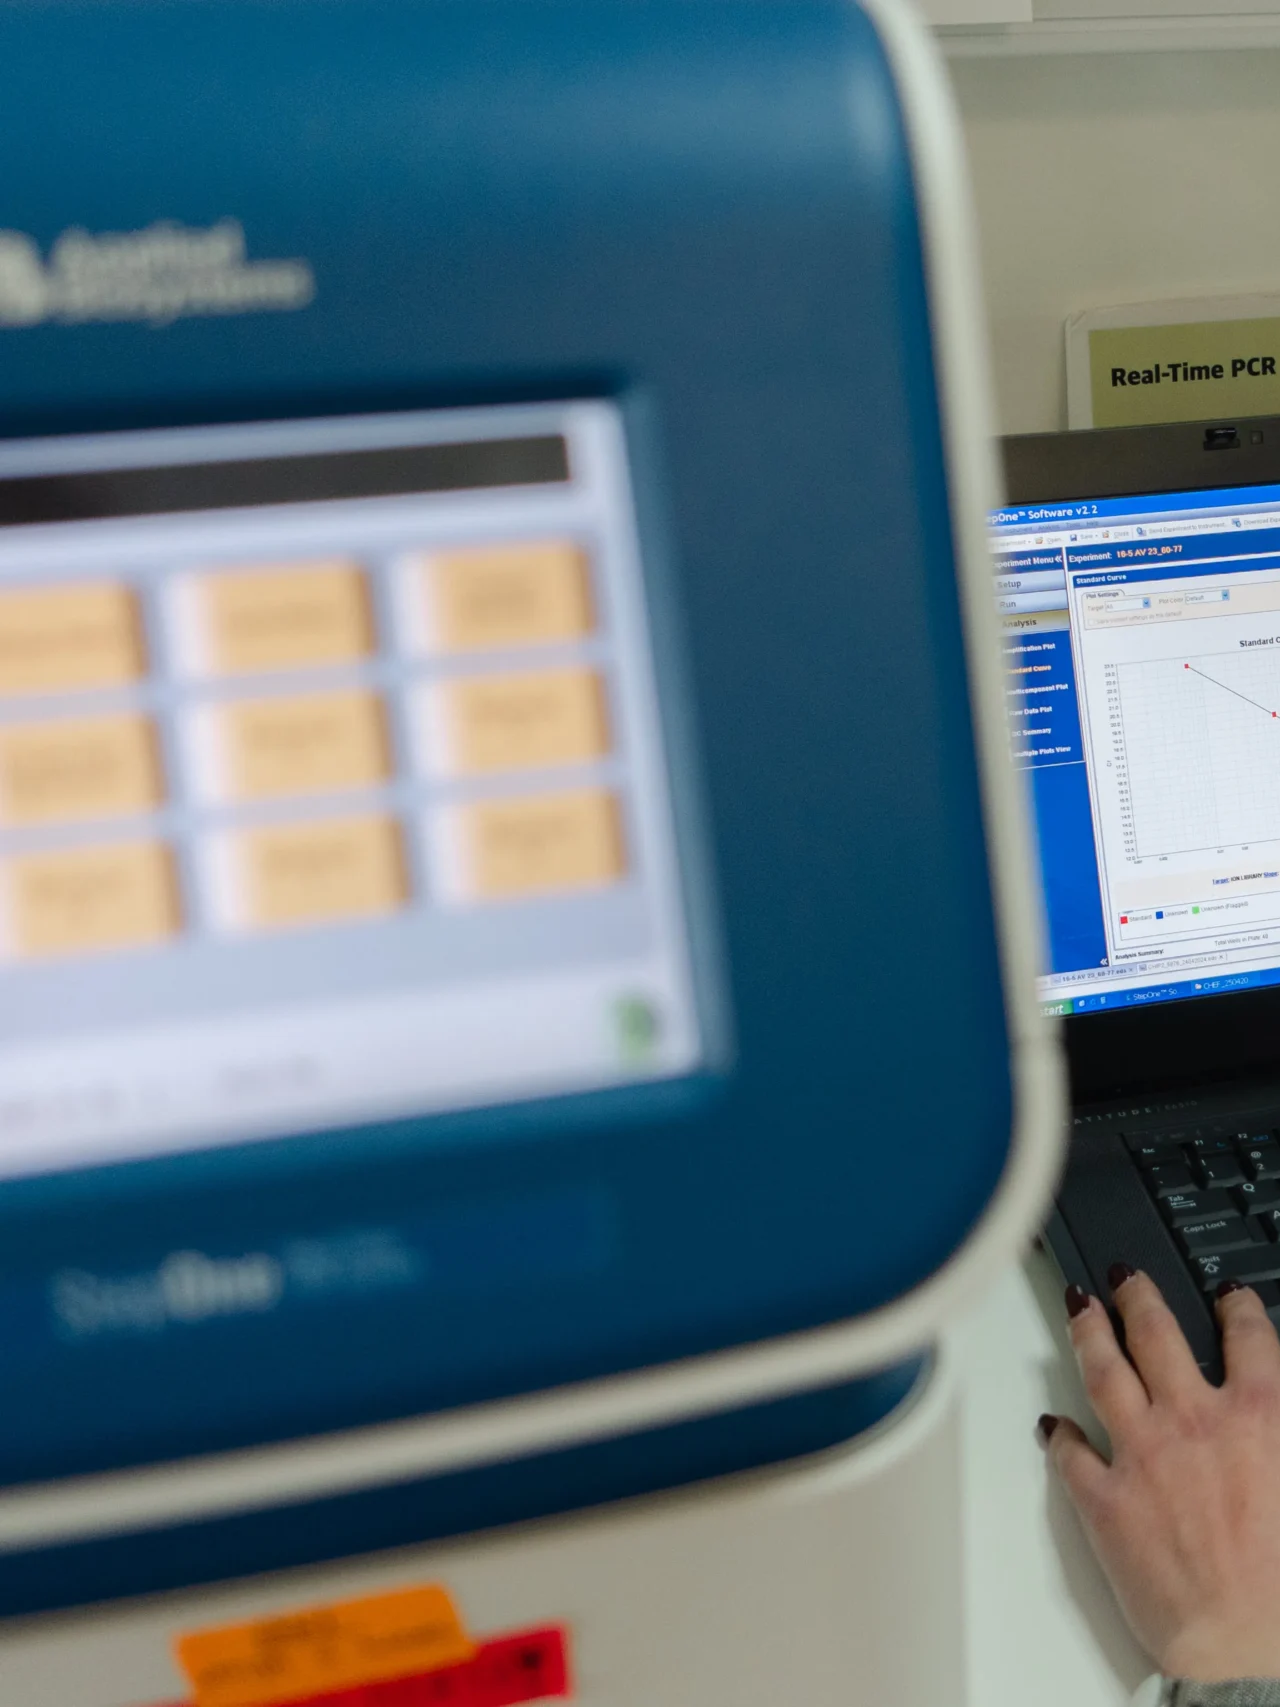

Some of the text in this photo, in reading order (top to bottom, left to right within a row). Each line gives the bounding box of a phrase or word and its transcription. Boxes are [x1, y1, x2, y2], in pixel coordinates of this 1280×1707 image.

[1111, 356, 1276, 387] Real-Time PCR
[1028, 505, 1098, 519] Software v2.2
[1135, 549, 1146, 557] AV
[1033, 556, 1054, 565] Menu
[1076, 574, 1127, 584] Standard Curve
[1240, 637, 1274, 647] Standard
[1033, 664, 1051, 672] Curve
[1024, 705, 1052, 715] Data Plot
[1115, 949, 1164, 960] Analysis Summary:
[1243, 1183, 1255, 1192] Q
[1183, 1221, 1227, 1233] Caps Lock
[1199, 1255, 1220, 1264] Shift
